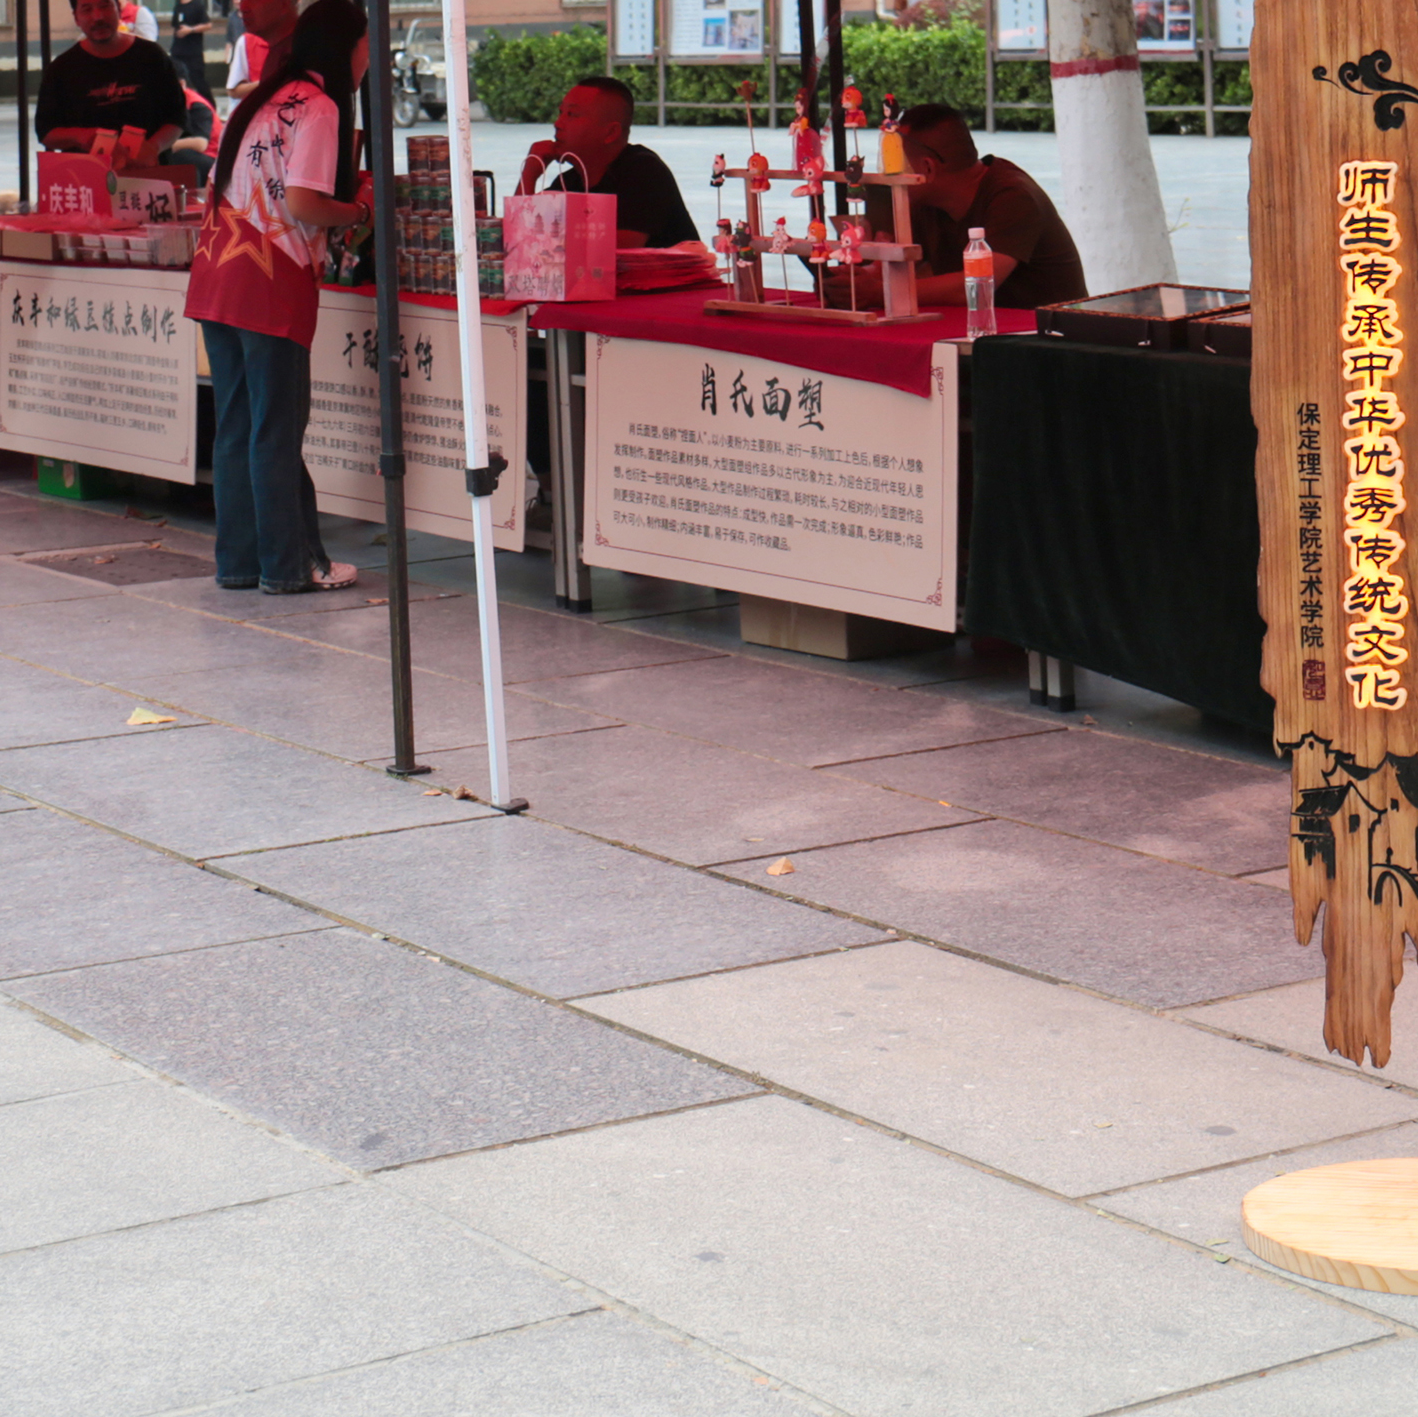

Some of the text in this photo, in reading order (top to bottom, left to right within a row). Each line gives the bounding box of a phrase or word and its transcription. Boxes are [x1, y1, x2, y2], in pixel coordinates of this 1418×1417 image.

[50, 184, 94, 215] 庆丰和
[701, 362, 825, 431] 肖氏面塑
[1340, 162, 1404, 708] 师生传承中华优秀传统文化
[1297, 402, 1324, 649] 保定理工学院艺术学院
